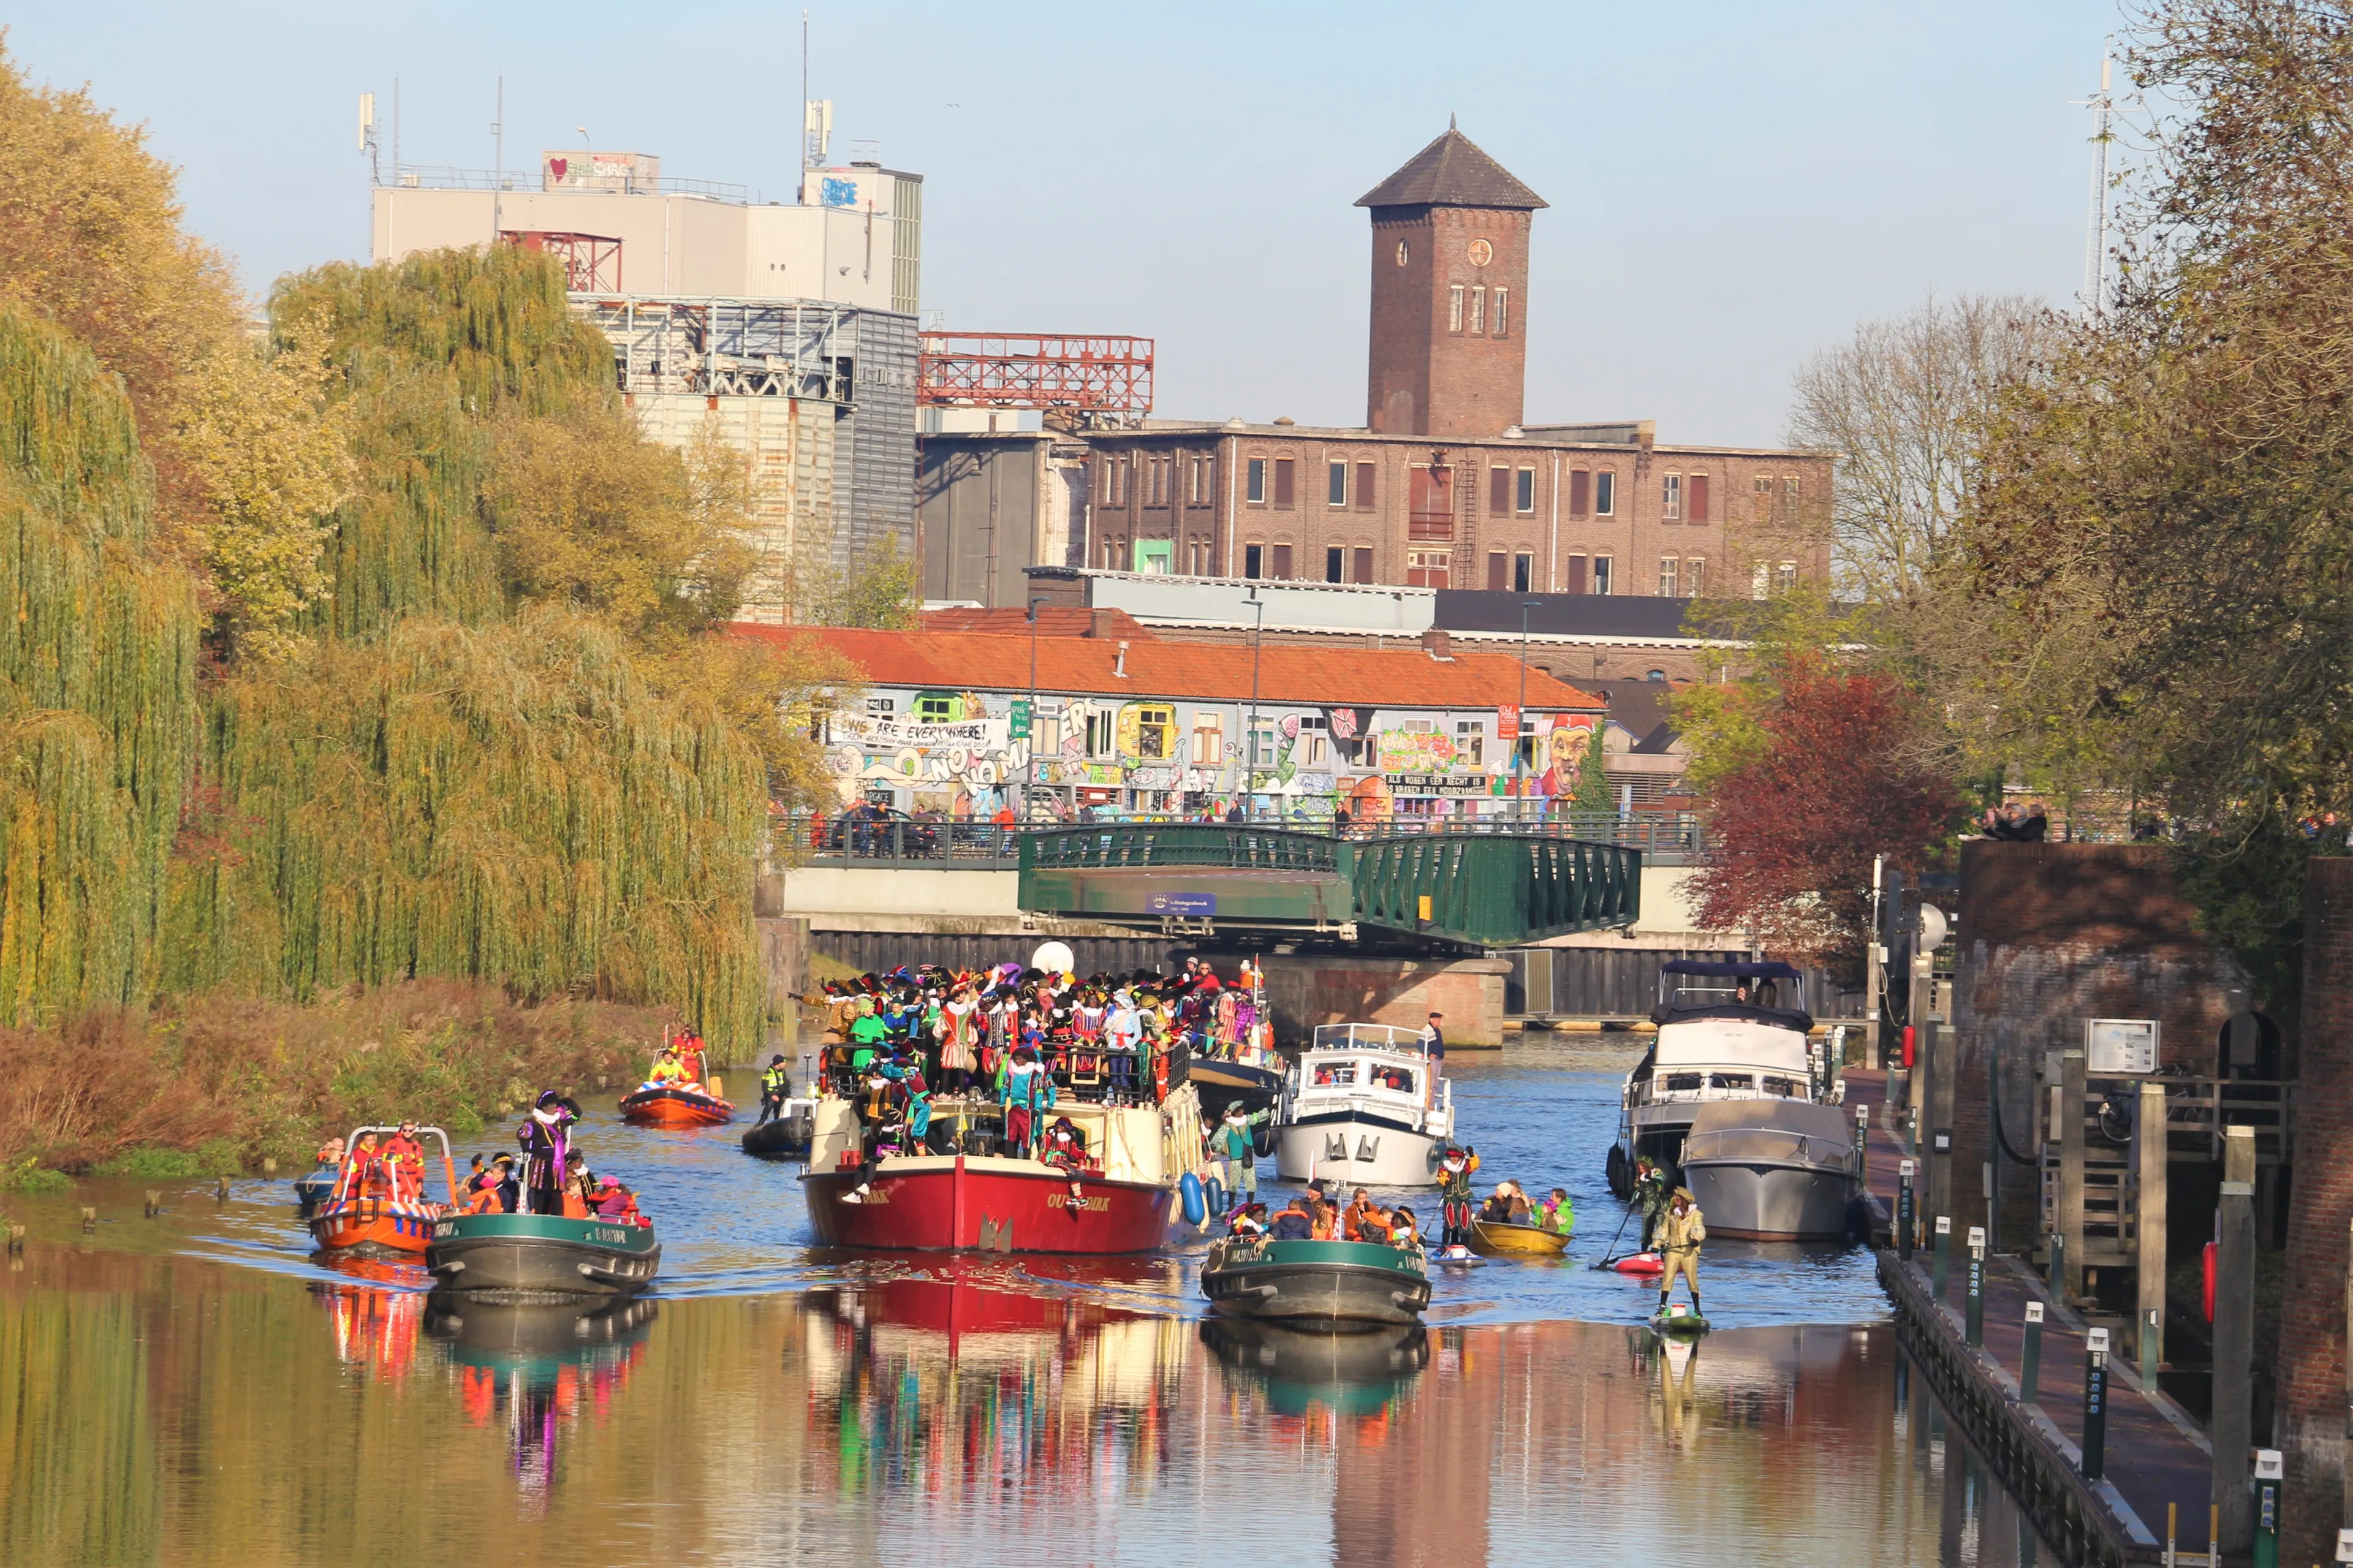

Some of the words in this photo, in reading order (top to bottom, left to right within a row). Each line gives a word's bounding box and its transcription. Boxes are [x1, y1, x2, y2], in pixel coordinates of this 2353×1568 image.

[877, 722, 900, 737] ARE
[907, 724, 986, 743] EVERYWHERE!
[1388, 775, 1401, 784] ALS
[1405, 776, 1426, 784] WONEN
[1430, 777, 1442, 786] EEN
[1447, 777, 1468, 786] RECHT
[1395, 785, 1420, 793] KRAKEN
[1439, 786, 1473, 795] NOODZAAK
[1083, 1196, 1110, 1211] DIRK
